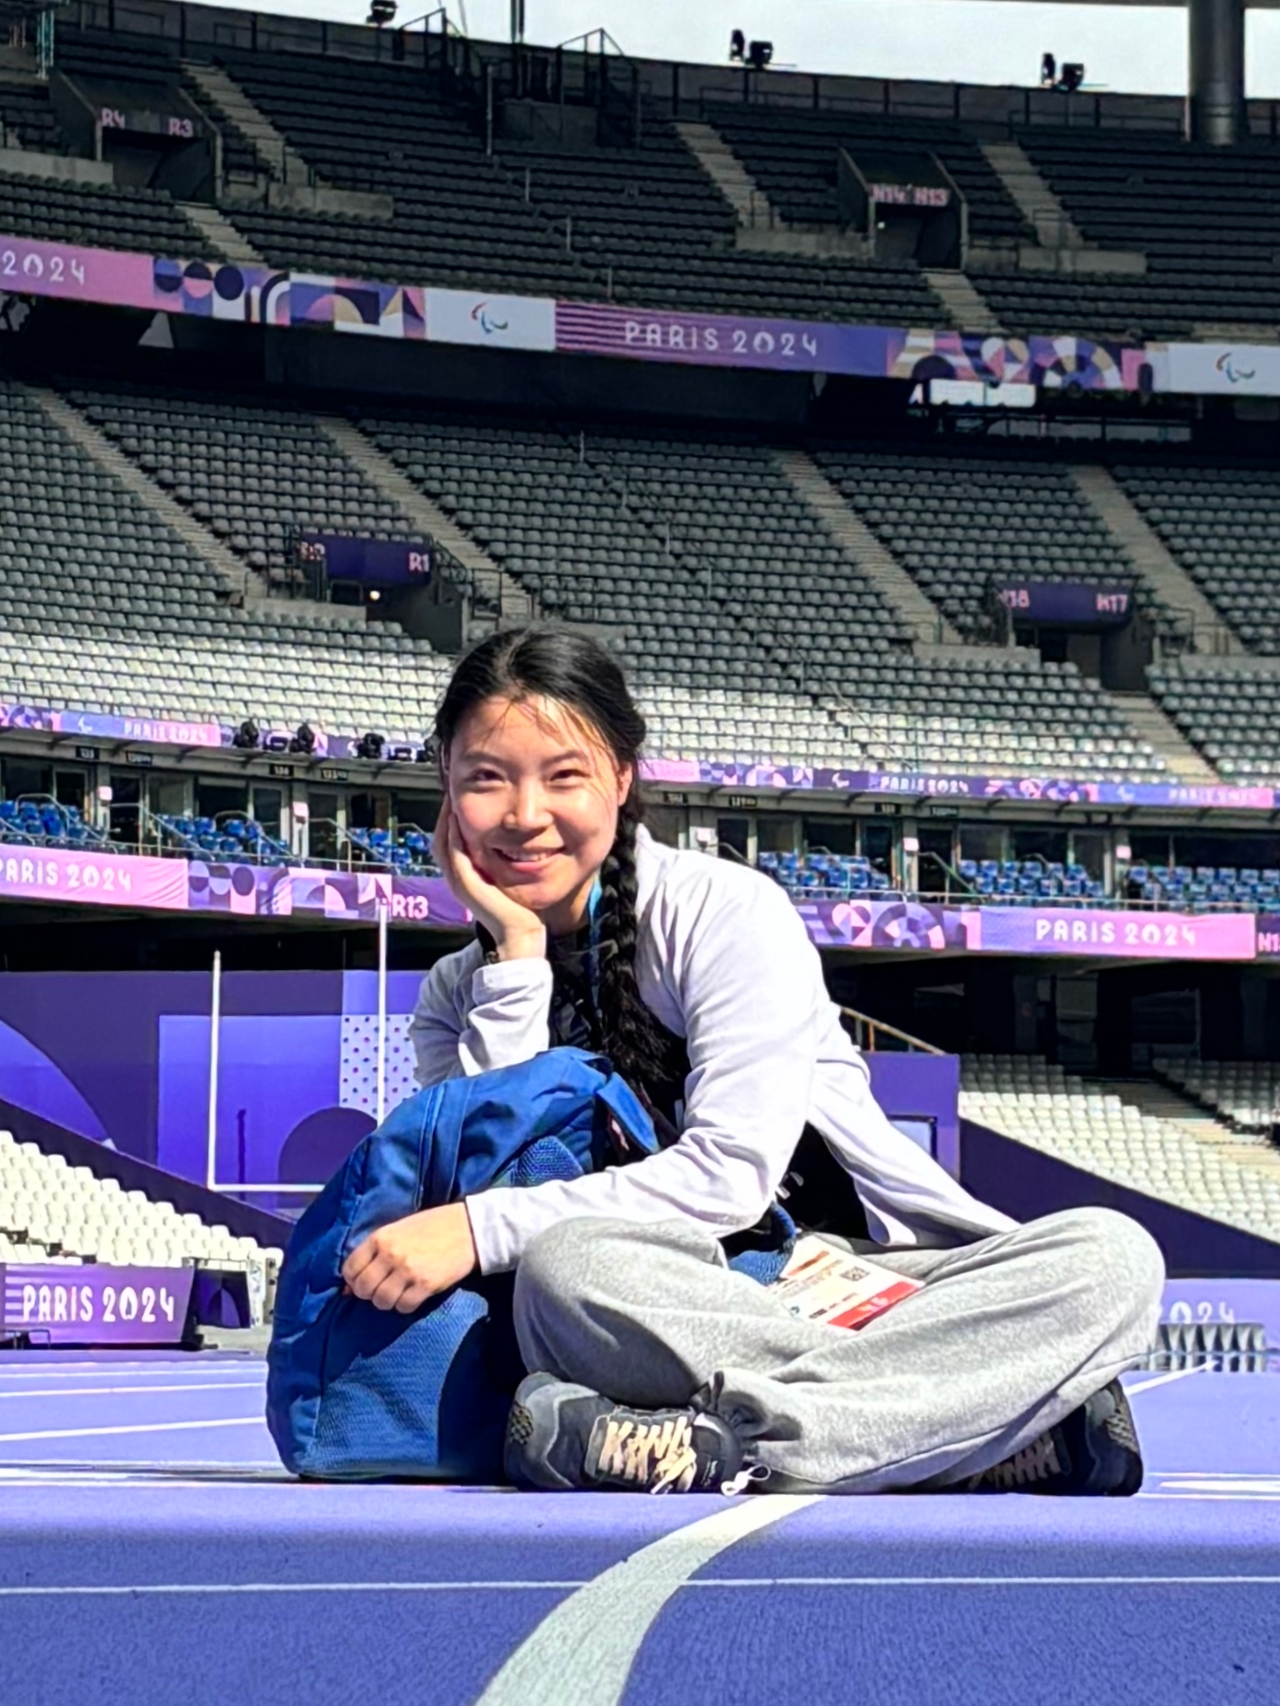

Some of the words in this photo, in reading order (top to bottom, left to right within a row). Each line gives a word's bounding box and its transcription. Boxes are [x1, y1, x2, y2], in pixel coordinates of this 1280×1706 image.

[2, 250, 85, 285] 2024
[625, 321, 719, 351] PARIS
[732, 330, 817, 357] 2024
[408, 552, 429, 572] R1
[66, 863, 131, 892] 2024
[392, 894, 429, 920] R13
[1035, 919, 1115, 943] PARIS
[1123, 921, 1196, 946] 2024
[102, 1286, 174, 1323] 2024
